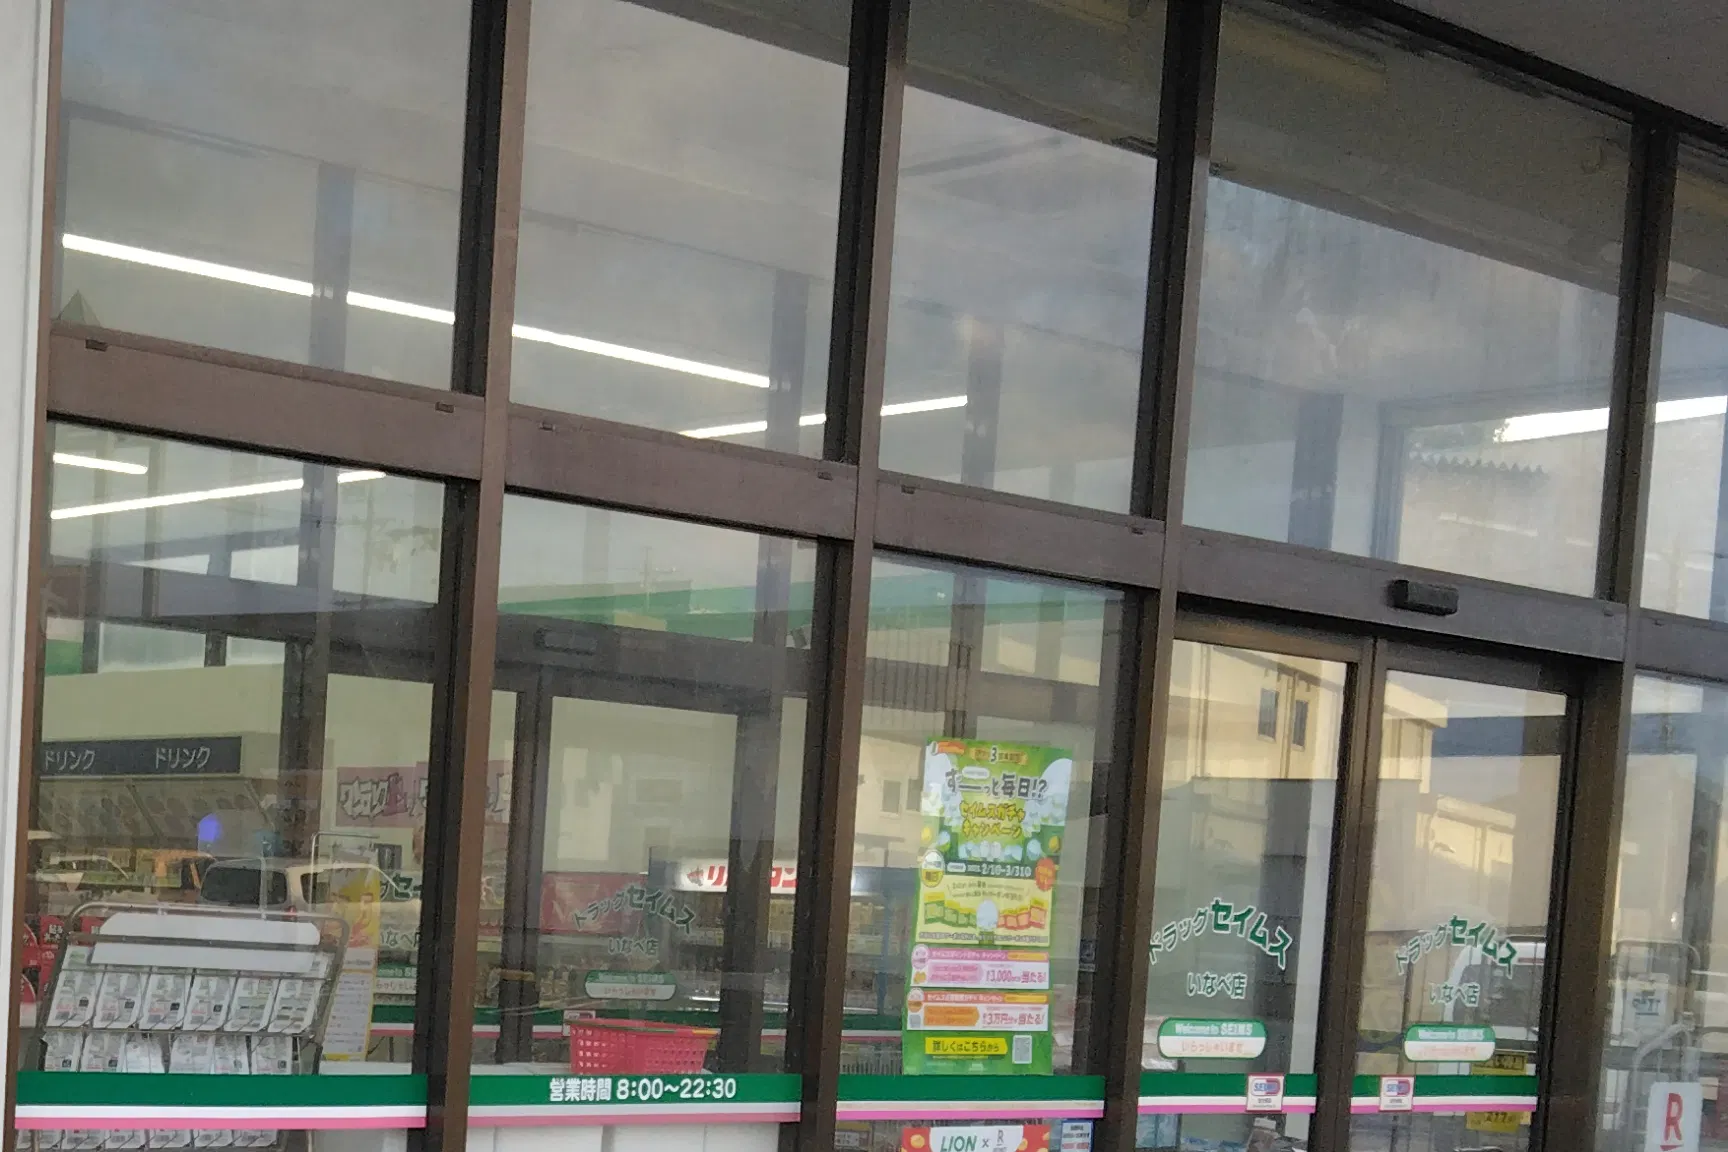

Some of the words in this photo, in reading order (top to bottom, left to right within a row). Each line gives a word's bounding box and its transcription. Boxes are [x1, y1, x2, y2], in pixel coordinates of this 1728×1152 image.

[45, 749, 95, 770] ドリンク
[155, 746, 210, 769] ドリンク
[1149, 897, 1293, 970] ドラッグセイムス
[1187, 971, 1248, 999] いなべ店
[1430, 981, 1480, 1007] いなべ店
[933, 1040, 1000, 1053] 詳しくはこちらから
[549, 1077, 612, 1102] 営業時間
[1664, 1092, 1683, 1141] R
[940, 1136, 977, 1152] LION
